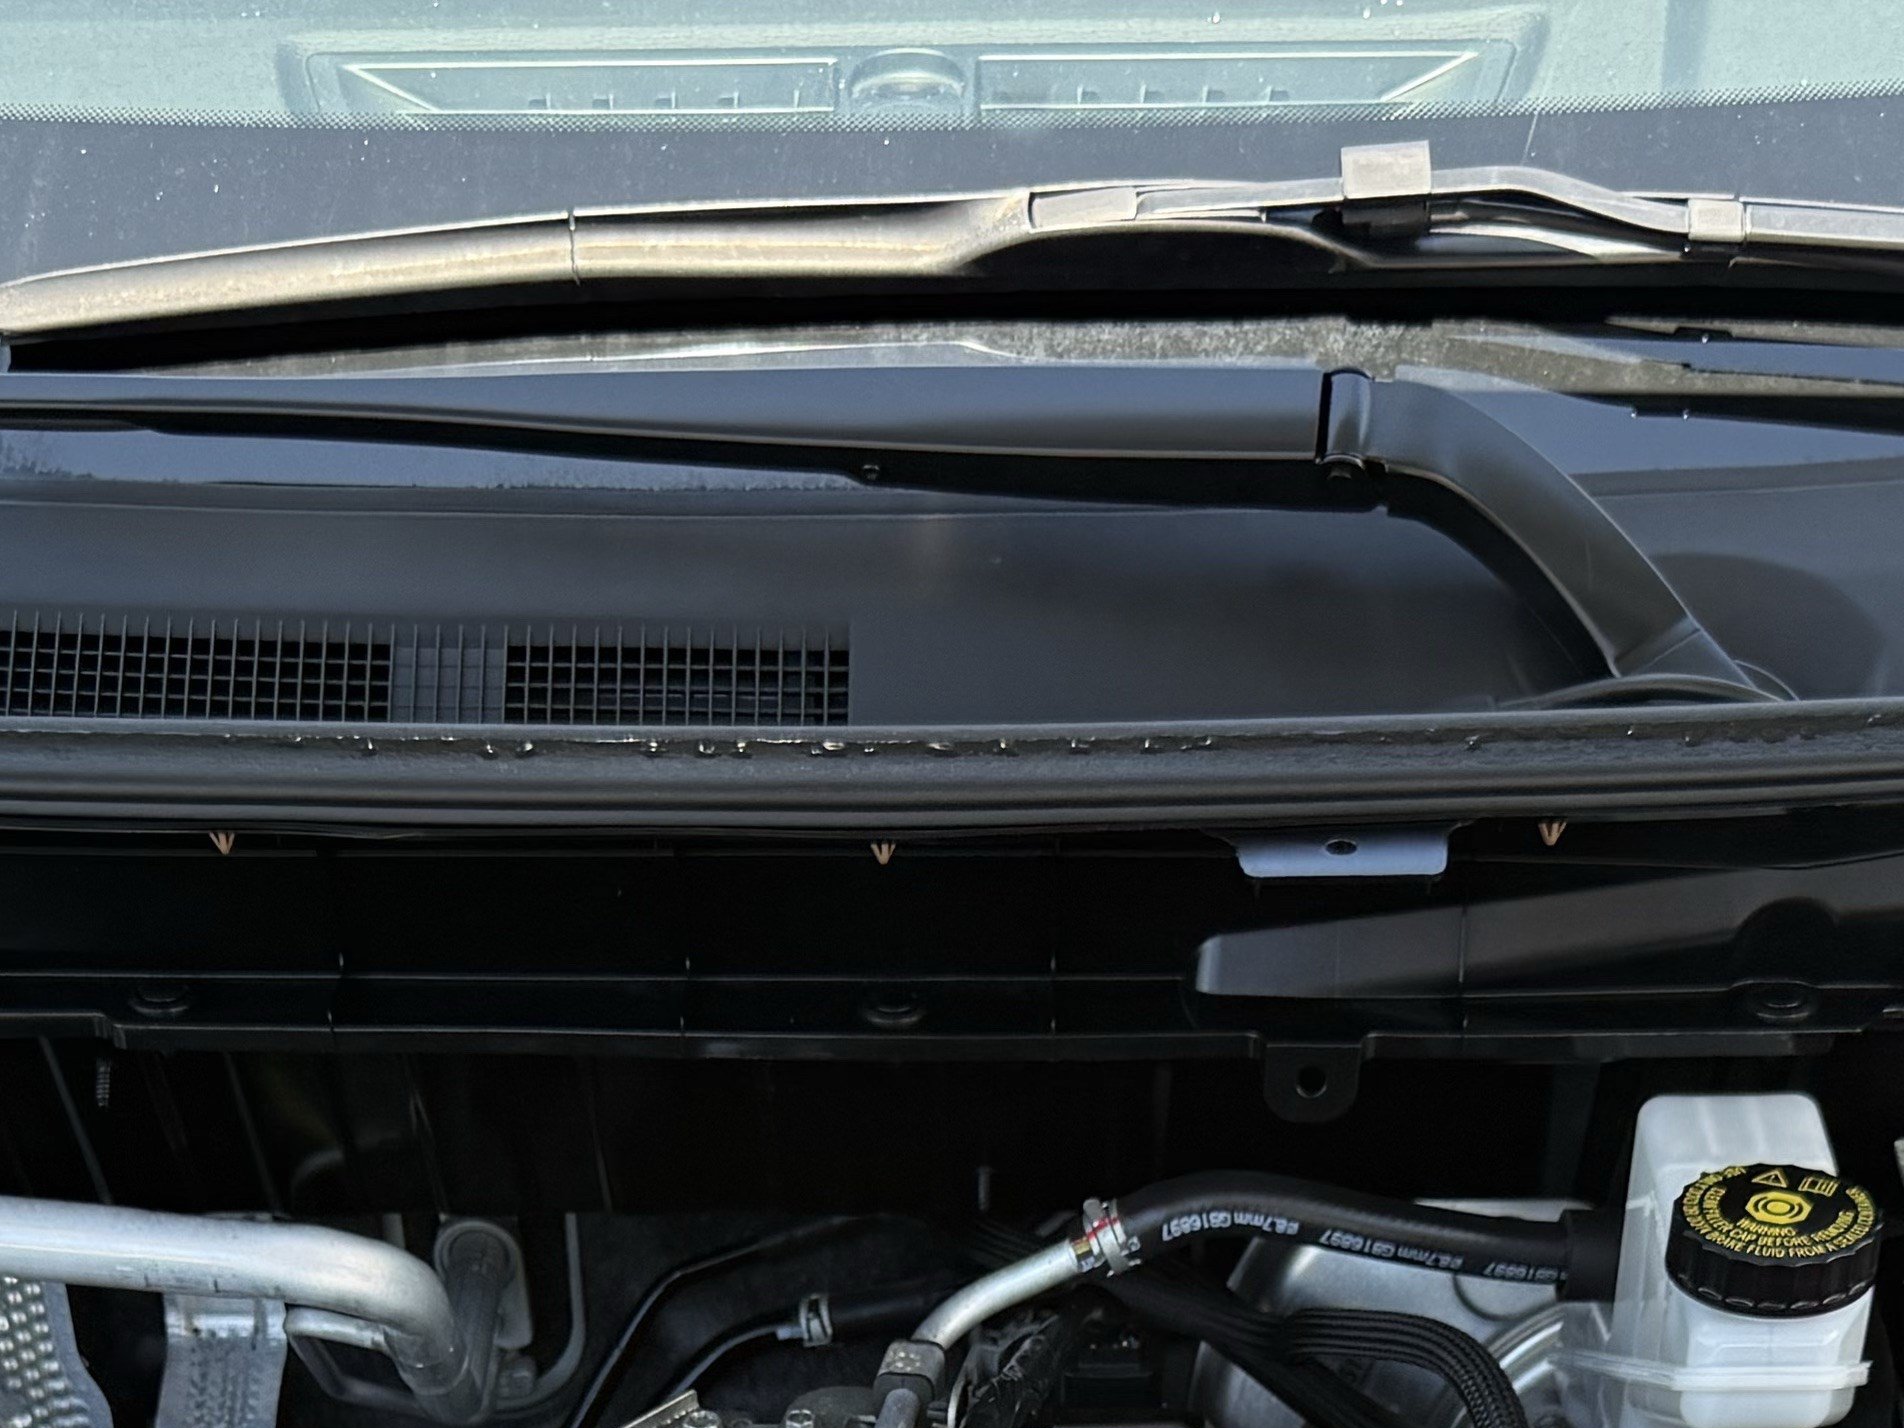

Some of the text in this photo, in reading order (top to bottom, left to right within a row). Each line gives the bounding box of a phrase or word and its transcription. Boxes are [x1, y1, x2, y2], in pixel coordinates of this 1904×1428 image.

[1705, 1231, 1744, 1253] BRAKE
[1746, 1245, 1785, 1259] FLUID
[1788, 1245, 1825, 1259] FROM
[1826, 1241, 1837, 1253] A
[1729, 1227, 1757, 1243] CAP
[1758, 1234, 1813, 1248] BEFORE
